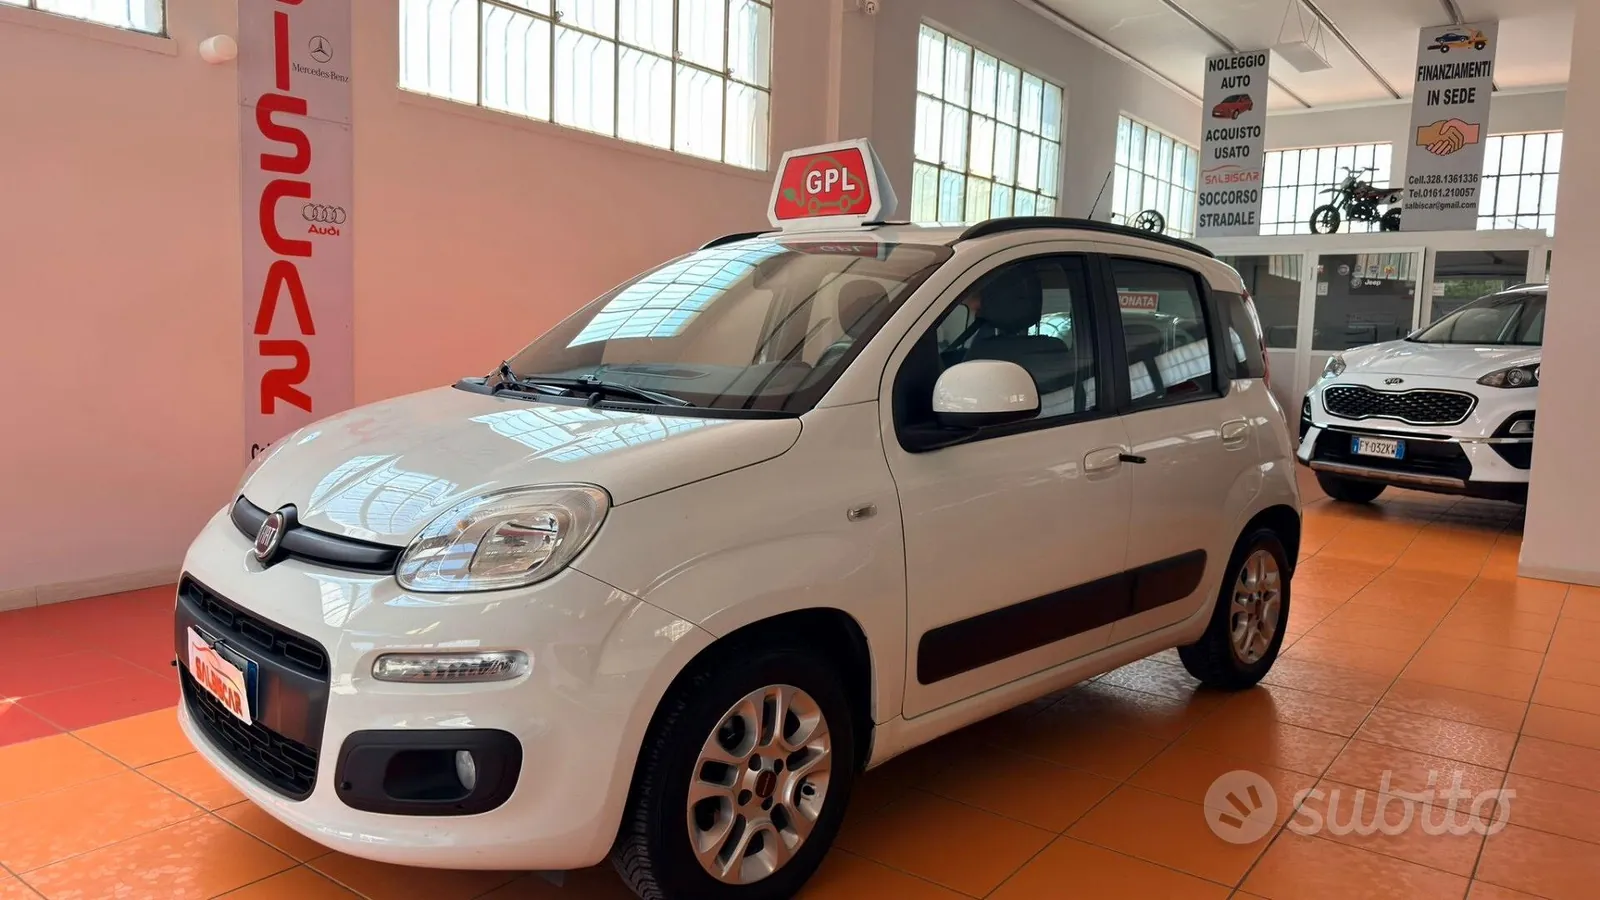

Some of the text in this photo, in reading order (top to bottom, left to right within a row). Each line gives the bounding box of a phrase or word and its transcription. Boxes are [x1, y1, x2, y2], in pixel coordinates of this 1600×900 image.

[1208, 54, 1266, 72] NOLEGGIO
[1417, 60, 1491, 82] FINANZIAMENTI
[292, 62, 349, 83] Mercedes-Benz
[1220, 75, 1251, 89] AUTO
[1427, 87, 1476, 106] IN SEDE
[1205, 125, 1261, 142] ACQUISTO
[1214, 145, 1250, 159] USATO
[806, 167, 856, 195] GPL
[1205, 171, 1260, 184] SALBISCAR
[1408, 173, 1478, 185] Cell.328.1361336
[1199, 189, 1258, 206] SOCCORSO
[1409, 187, 1475, 198] Tel.0161.210057
[254, 0, 315, 415] ISCAR
[1404, 200, 1477, 211] salbiscar@gmail.com
[1199, 211, 1255, 228] STRADALE
[308, 224, 340, 236] Audi
[1364, 278, 1382, 287] Jeep
